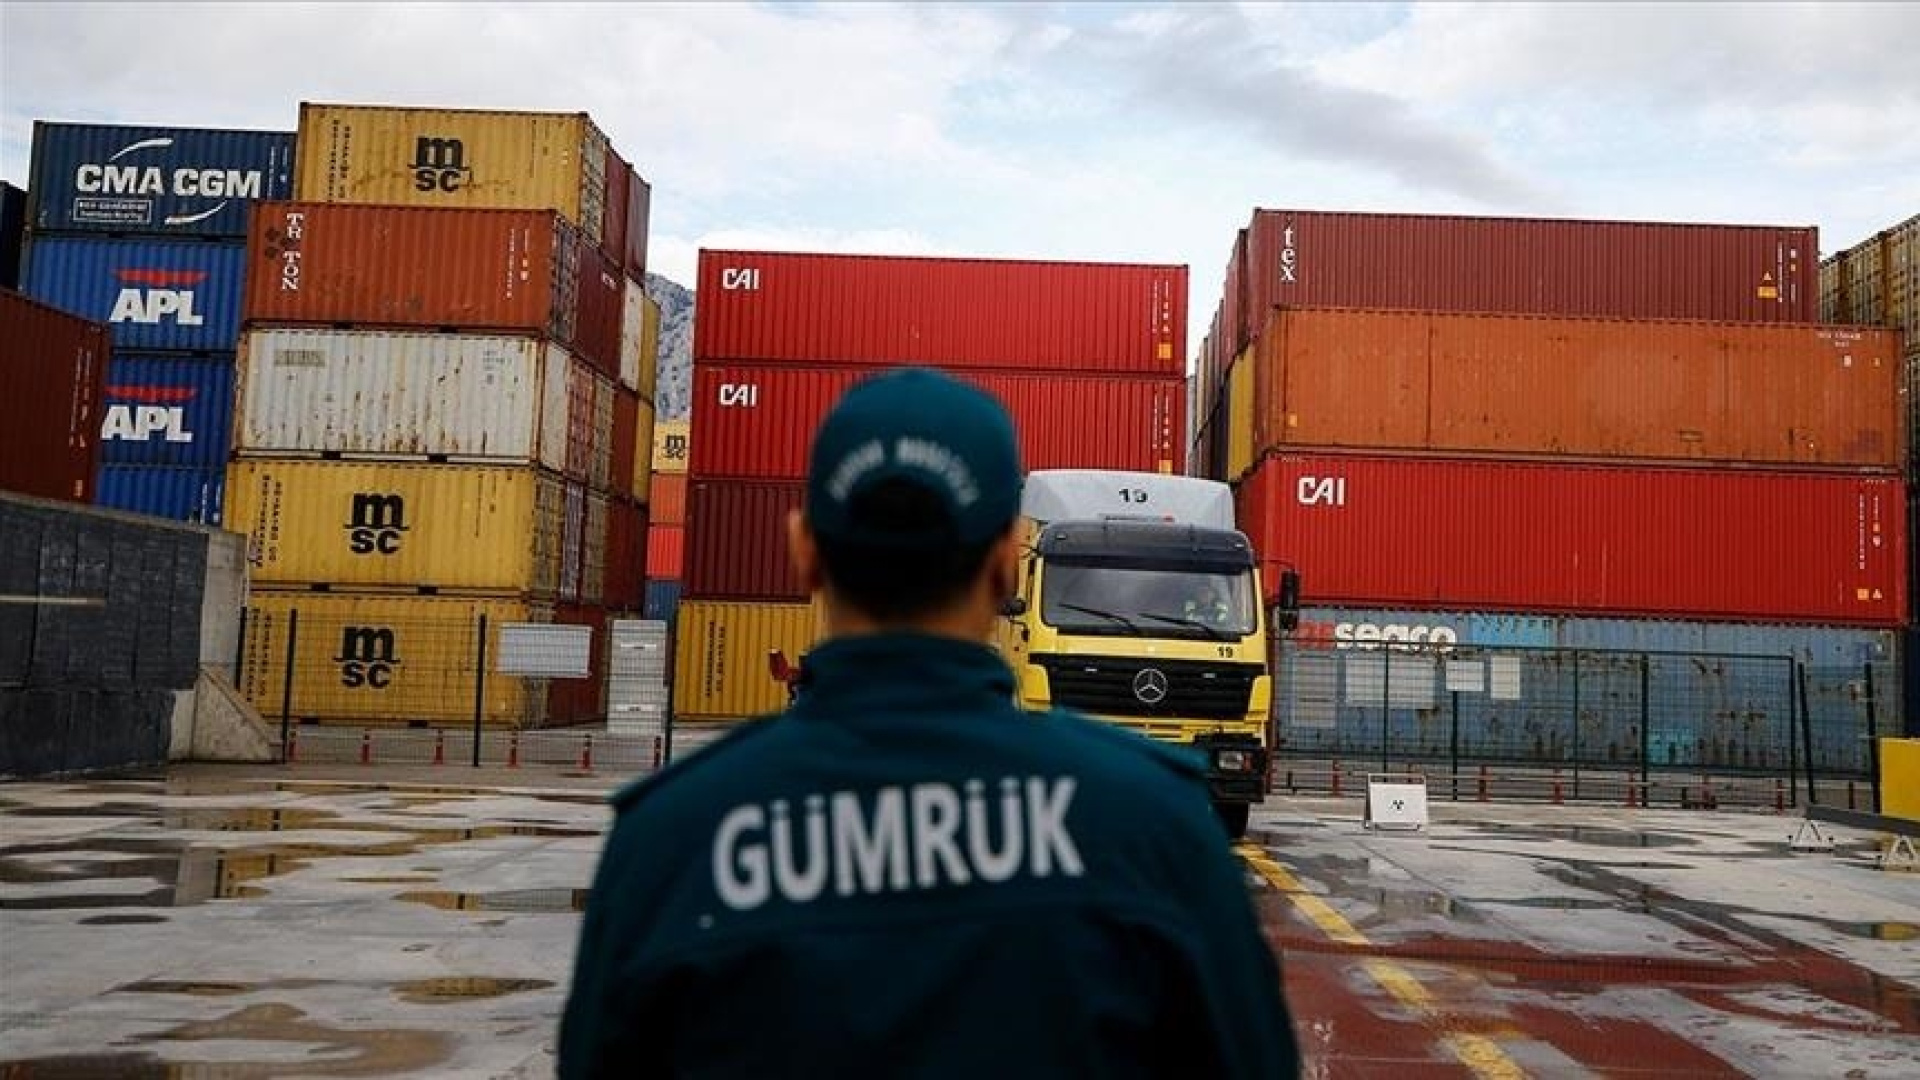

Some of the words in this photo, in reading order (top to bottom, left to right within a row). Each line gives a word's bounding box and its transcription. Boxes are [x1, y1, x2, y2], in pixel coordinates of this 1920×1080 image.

[77, 163, 165, 194] CMA
[173, 168, 262, 198] CGM
[1280, 226, 1296, 281] tex
[722, 268, 760, 290] CAI
[109, 288, 204, 325] APL
[720, 384, 758, 407] CAI
[101, 404, 193, 443] APL
[1118, 490, 1149, 503] 19
[1298, 476, 1345, 506] CAI
[1217, 645, 1234, 659] 19
[712, 775, 1085, 911] GÜMRÜK
